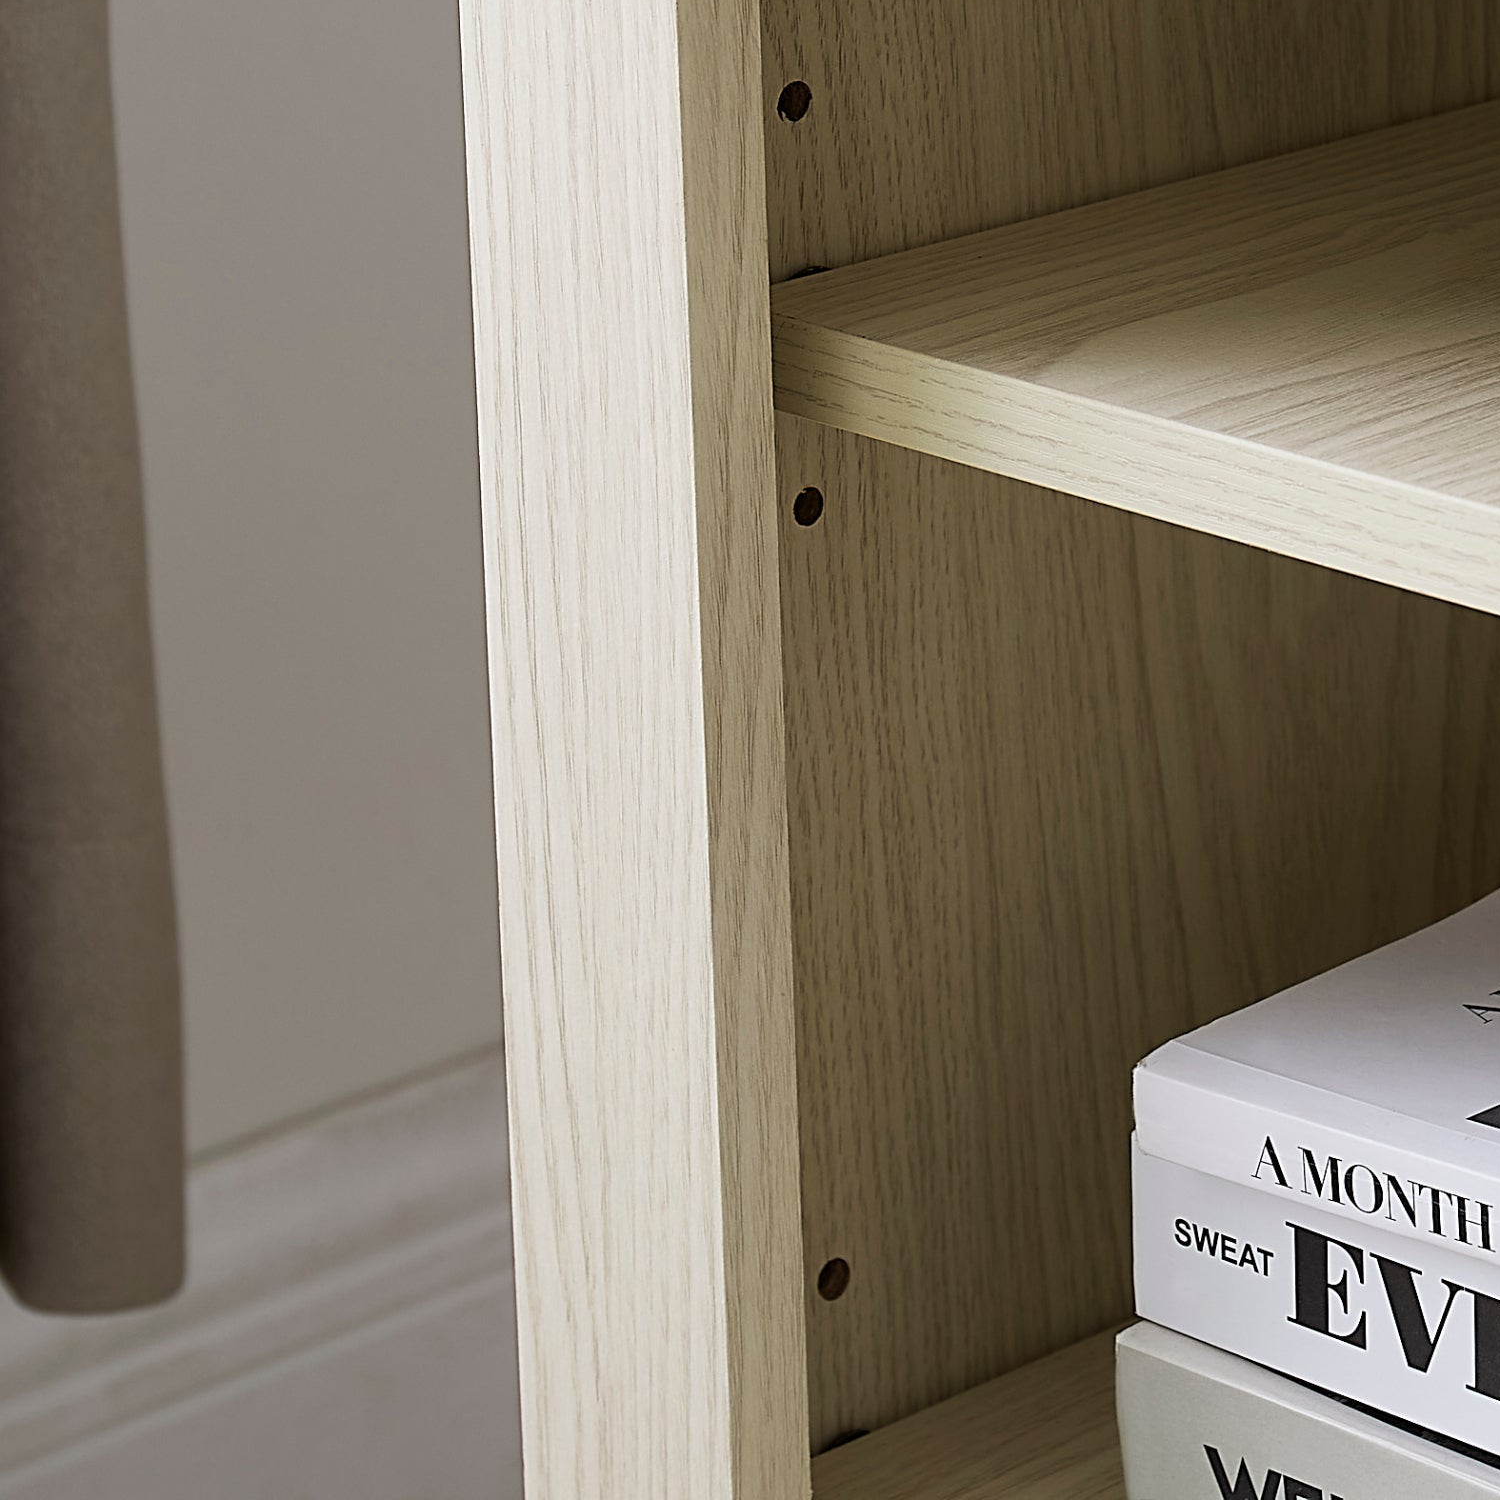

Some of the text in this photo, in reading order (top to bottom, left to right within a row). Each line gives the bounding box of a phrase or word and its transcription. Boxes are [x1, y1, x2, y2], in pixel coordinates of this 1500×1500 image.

[1253, 1135, 1292, 1188] A
[1297, 1146, 1496, 1253] MONTH
[1174, 1218, 1275, 1277] SWEAT
